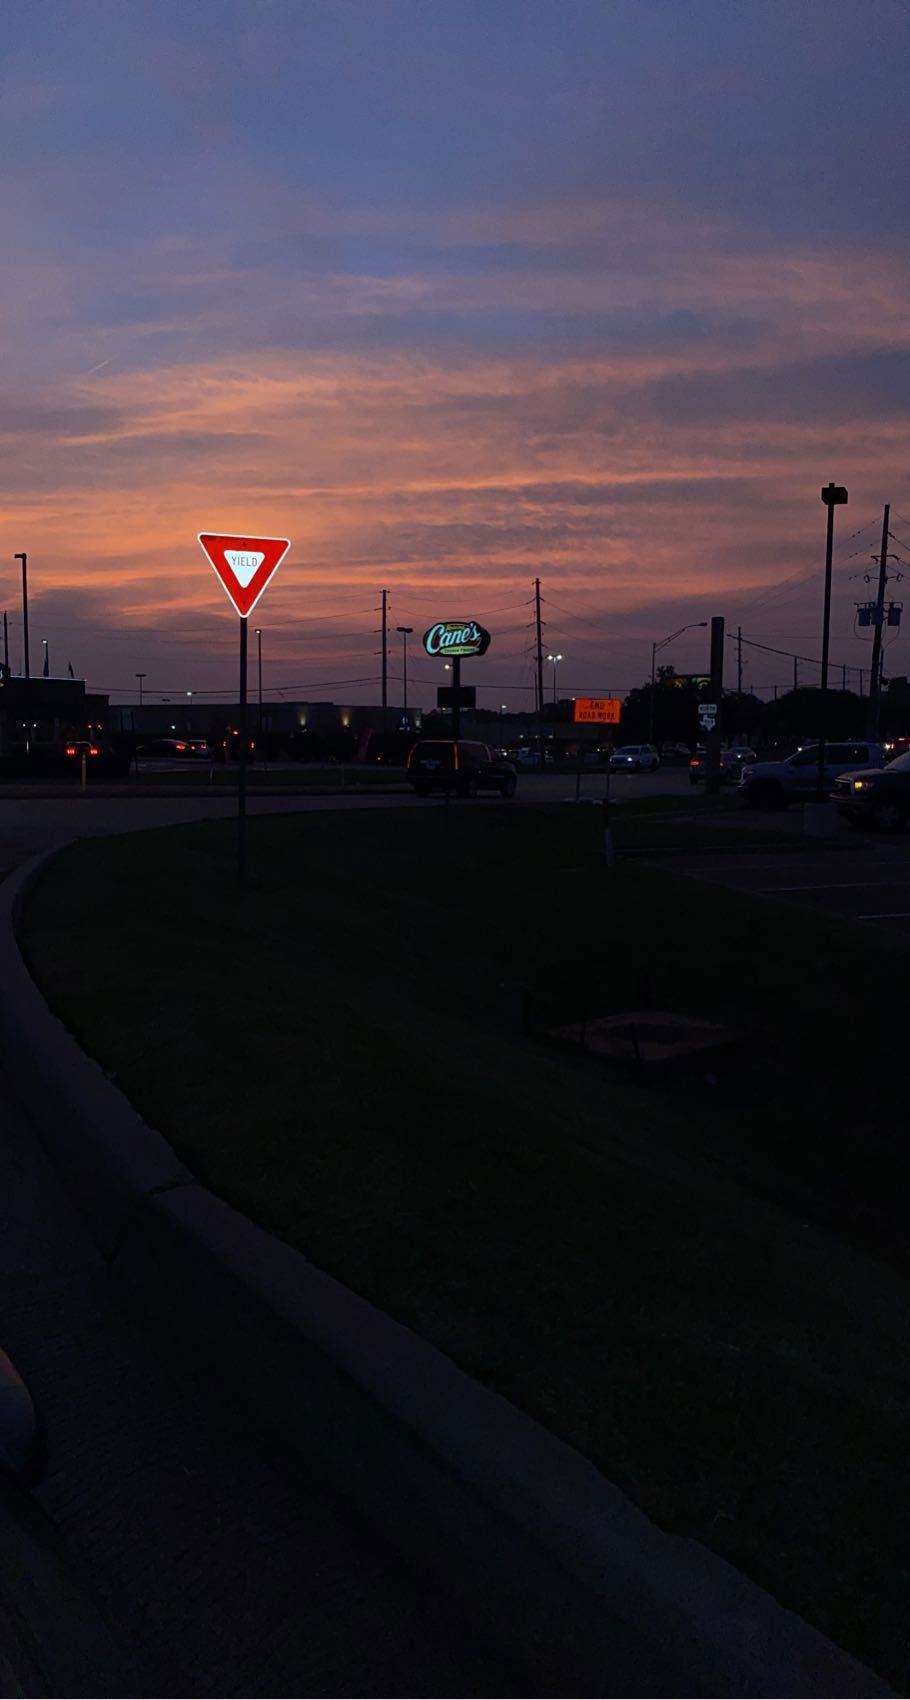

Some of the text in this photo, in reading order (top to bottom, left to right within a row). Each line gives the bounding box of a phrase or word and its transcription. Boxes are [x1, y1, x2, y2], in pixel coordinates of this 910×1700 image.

[231, 556, 258, 567] YIELD
[426, 623, 481, 654] Cane's
[590, 700, 605, 710] END
[578, 711, 615, 721] ROAD WORK
